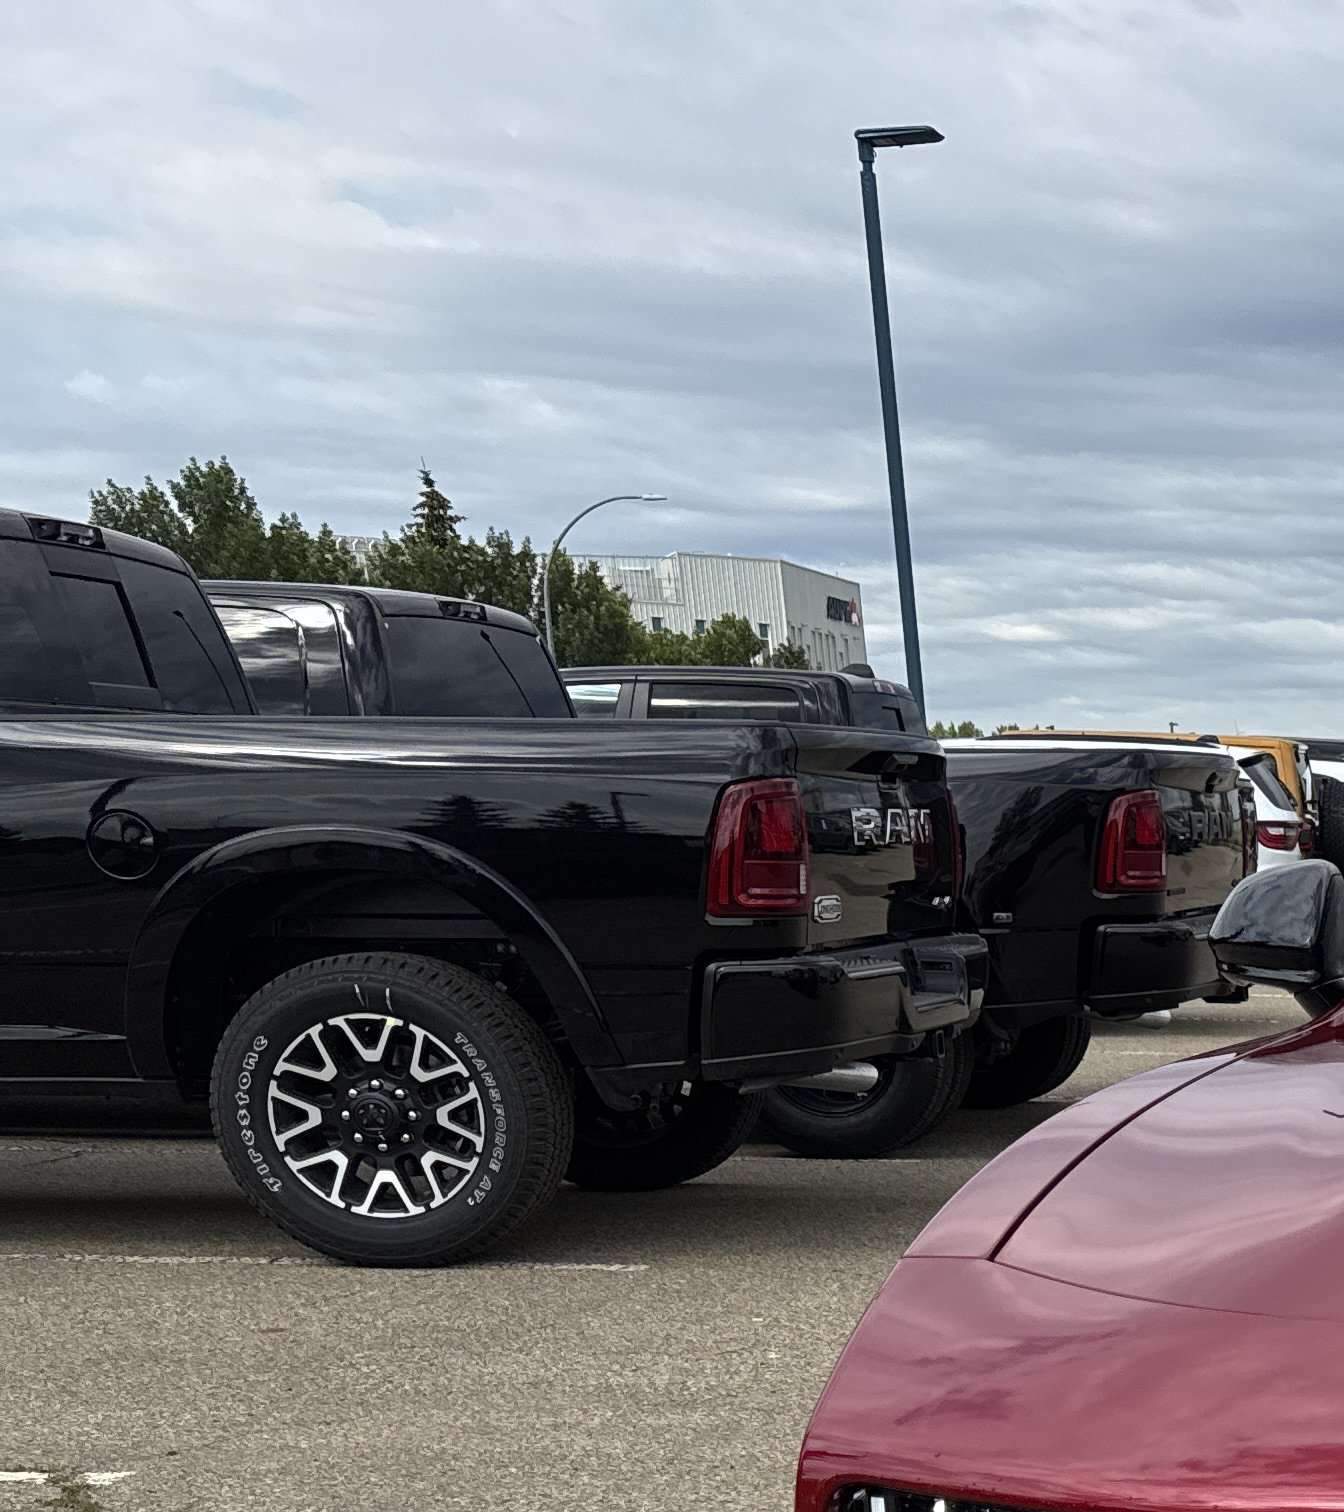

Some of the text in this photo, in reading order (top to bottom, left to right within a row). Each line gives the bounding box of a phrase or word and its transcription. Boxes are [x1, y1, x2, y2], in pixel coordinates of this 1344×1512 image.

[851, 808, 934, 845] RAM
[235, 1035, 283, 1192] Firestone
[454, 1032, 507, 1173] TRANSFORCE
